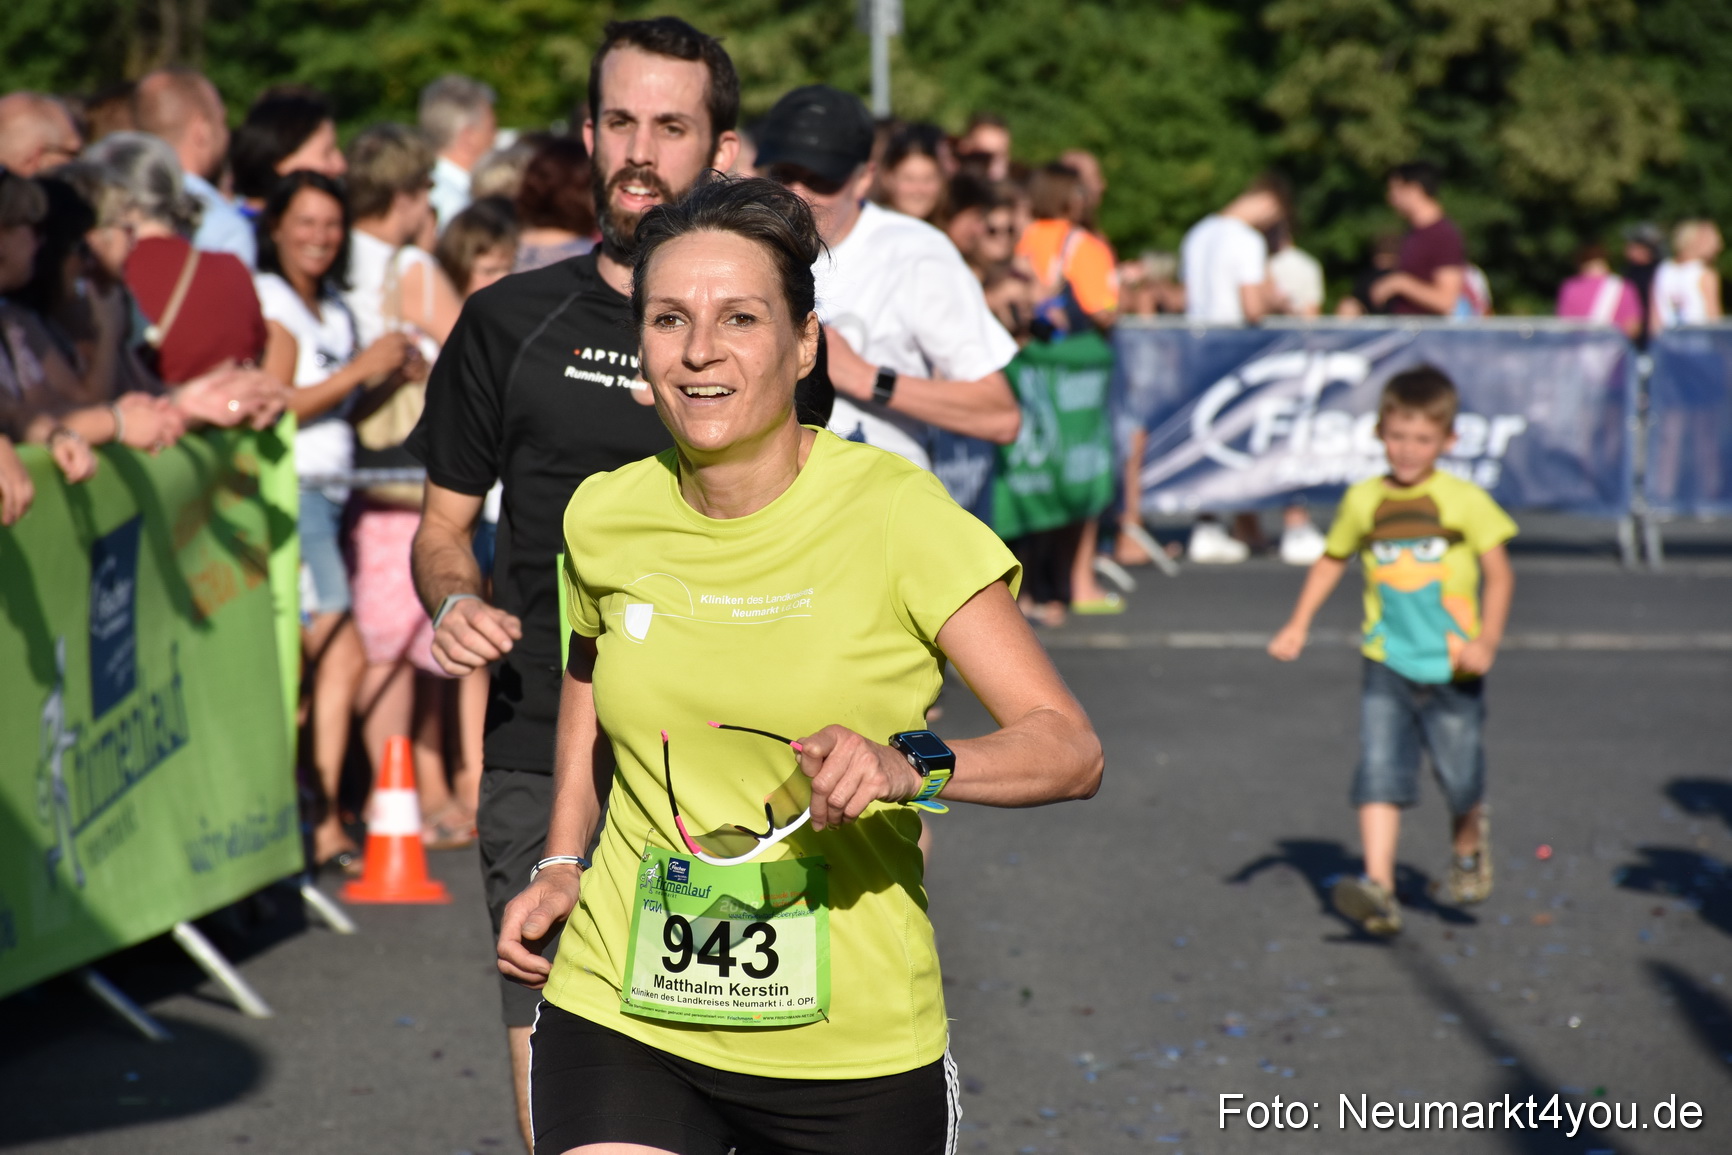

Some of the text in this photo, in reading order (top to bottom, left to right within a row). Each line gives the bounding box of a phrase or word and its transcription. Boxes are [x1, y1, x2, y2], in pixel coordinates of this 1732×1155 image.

[564, 365, 648, 391] Running Team
[1250, 400, 1527, 459] Fiscer
[700, 594, 744, 605] Kliniken
[747, 595, 763, 605] des
[732, 606, 779, 618] Neumarkt
[656, 875, 712, 899] firmenlauf
[662, 915, 779, 979] 943
[653, 974, 789, 997] Matthalm Kerstin
[631, 987, 816, 1008] Kliniken des Landkreises Neumarkt i. d. OPf.
